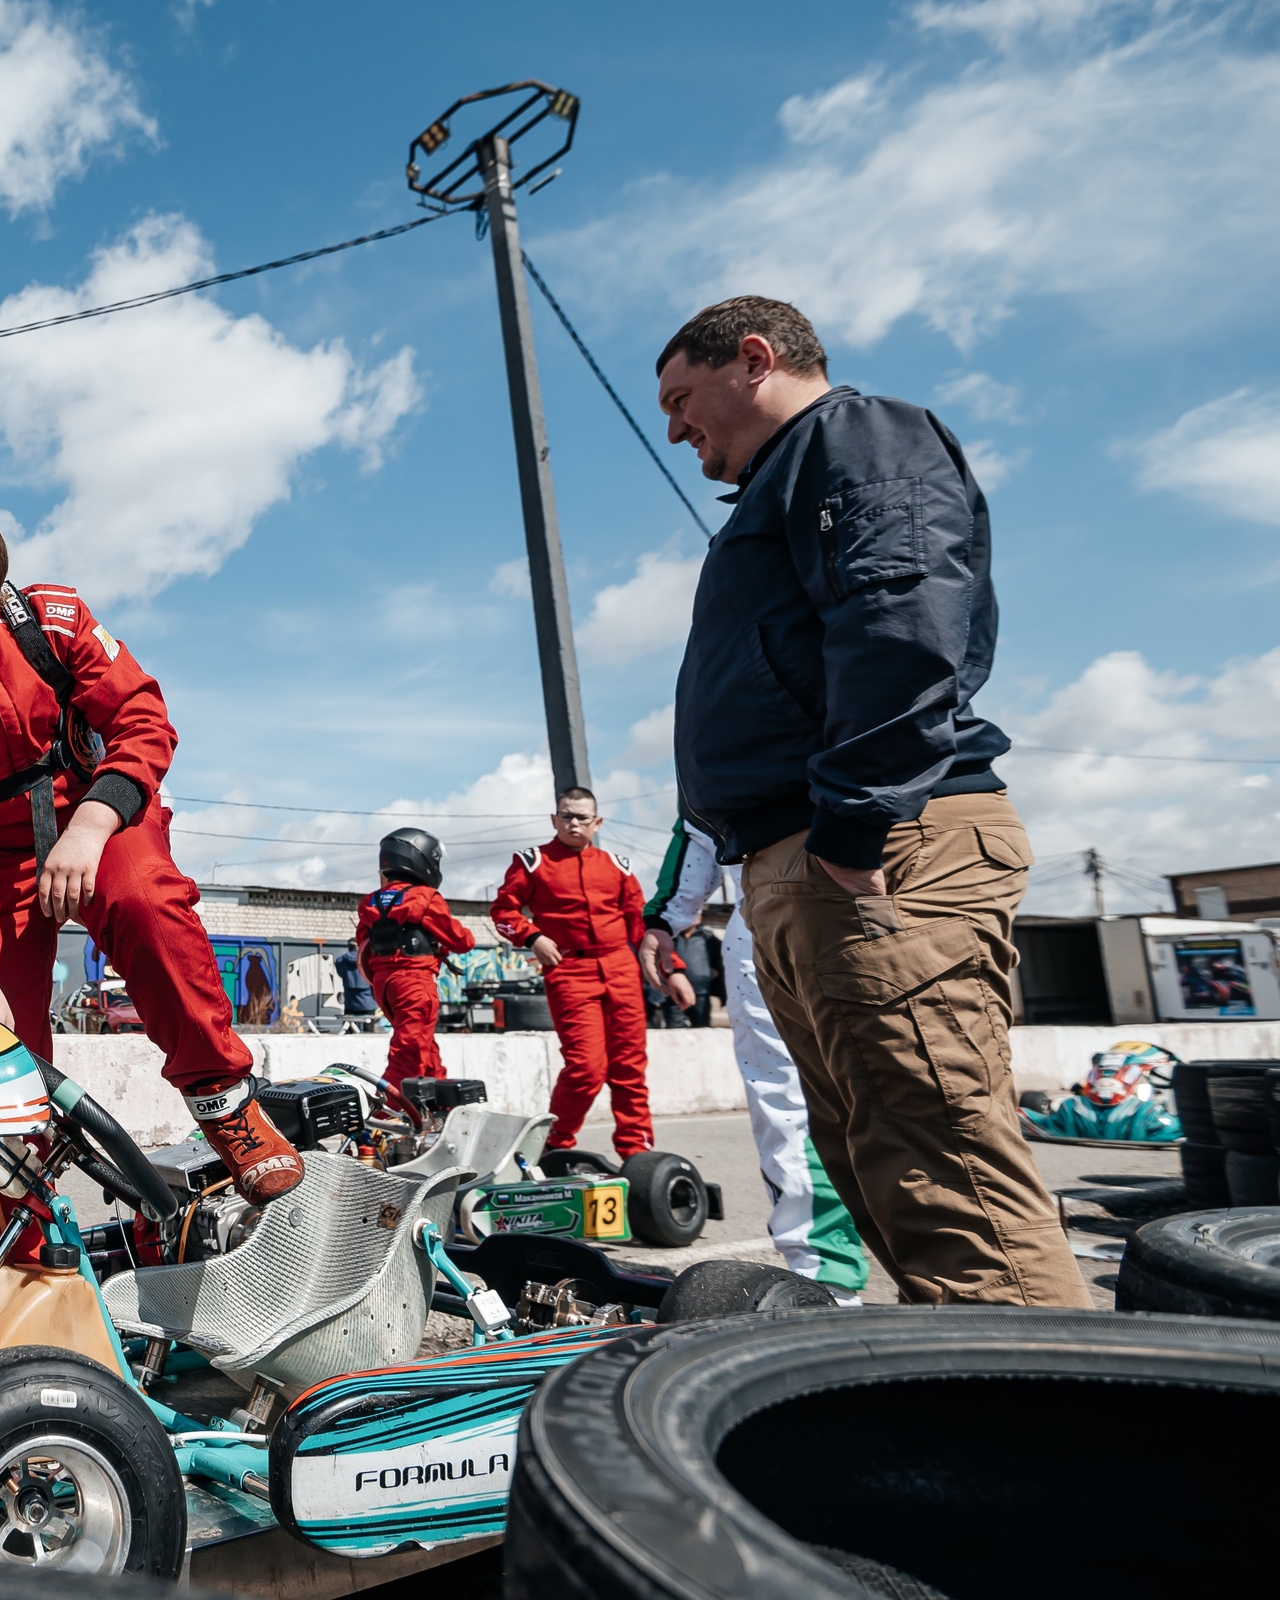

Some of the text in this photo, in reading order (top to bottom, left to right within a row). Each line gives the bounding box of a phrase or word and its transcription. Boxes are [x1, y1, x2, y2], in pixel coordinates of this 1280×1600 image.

[45, 606, 76, 618] OMP
[196, 1097, 228, 1113] OMP
[241, 1157, 298, 1193] OMP
[502, 1213, 543, 1226] NIKITA
[589, 1196, 617, 1229] 13
[355, 1453, 509, 1492] FORMULA
